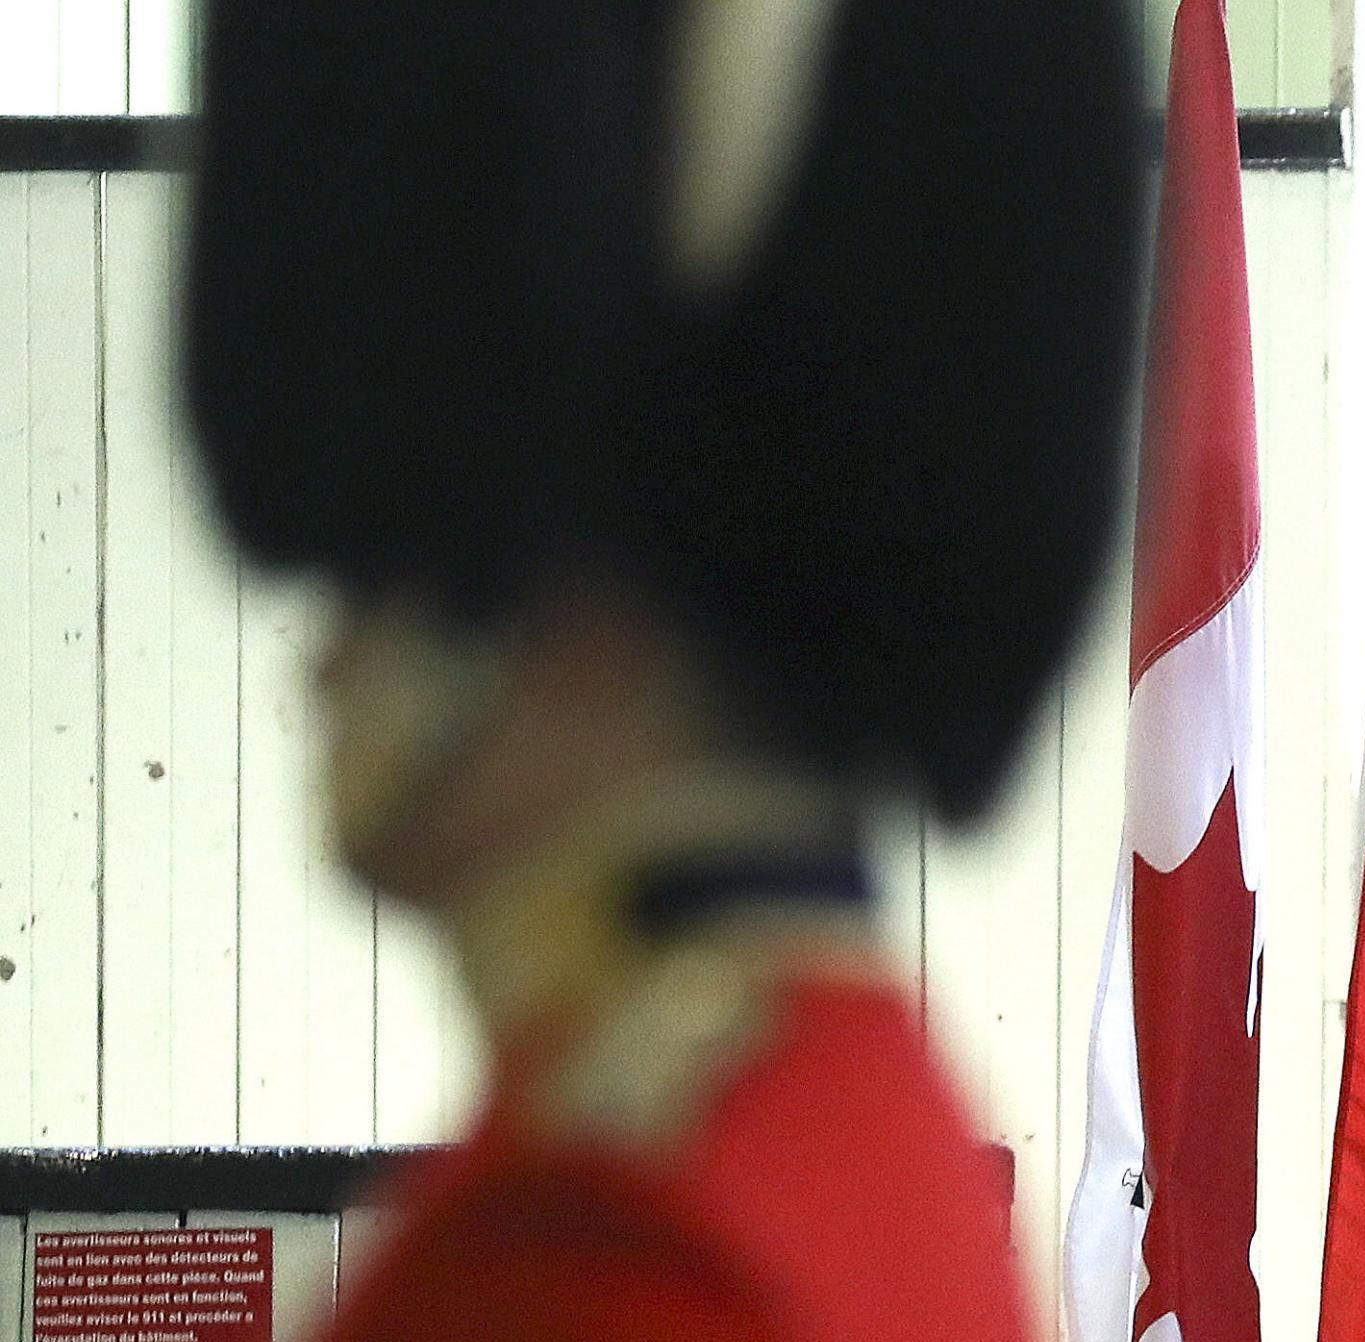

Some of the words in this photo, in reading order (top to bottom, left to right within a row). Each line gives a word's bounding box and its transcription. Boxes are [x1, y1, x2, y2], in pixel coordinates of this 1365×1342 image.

[37, 1237, 58, 1248] Les
[62, 1234, 139, 1247] avertisseurs
[144, 1233, 193, 1245] sonores
[196, 1233, 209, 1243] et
[212, 1230, 257, 1243] visuels
[37, 1254, 63, 1267] sont
[66, 1257, 82, 1266] en
[86, 1254, 109, 1265] lien
[112, 1254, 141, 1265] avec
[145, 1252, 167, 1264] des
[242, 1250, 258, 1262] de
[67, 1274, 84, 1286] de
[87, 1275, 109, 1289] gaz
[112, 1272, 142, 1285] dans
[145, 1272, 178, 1285] cette
[223, 1269, 264, 1283] Quand
[36, 1296, 58, 1307] ces
[62, 1293, 139, 1306] avertisseurs
[142, 1292, 169, 1304] sont
[173, 1293, 189, 1303] en
[86, 1313, 124, 1325] aviser
[127, 1311, 139, 1324] le
[143, 1310, 164, 1324] 911
[169, 1311, 182, 1323] et
[119, 1331, 135, 1342] du
